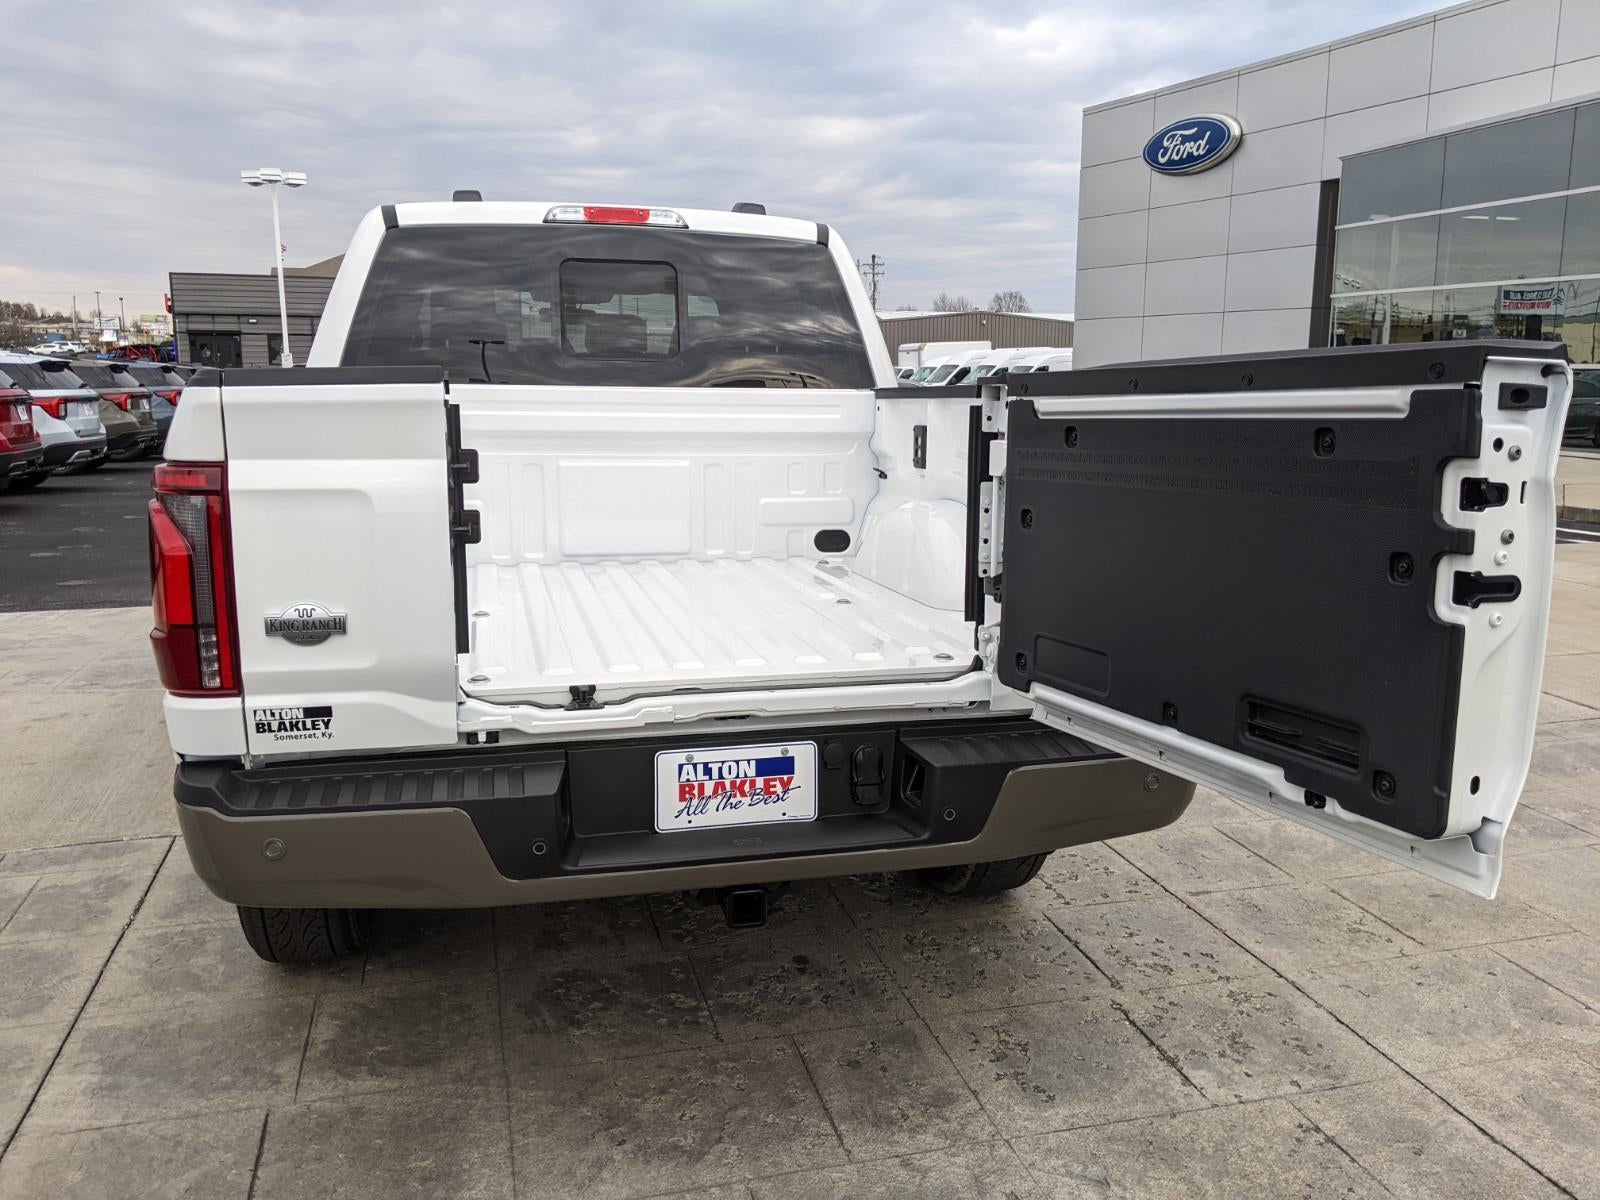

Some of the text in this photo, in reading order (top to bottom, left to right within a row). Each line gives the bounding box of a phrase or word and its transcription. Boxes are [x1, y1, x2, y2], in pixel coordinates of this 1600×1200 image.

[1157, 127, 1211, 164] Ford
[269, 617, 342, 632] KING RANCH
[255, 708, 304, 721] ALTON
[255, 719, 332, 734] BLAKLEY
[273, 731, 335, 741] Somerset, Ky.
[679, 760, 756, 783] ALTON
[674, 785, 801, 819] All The Best
